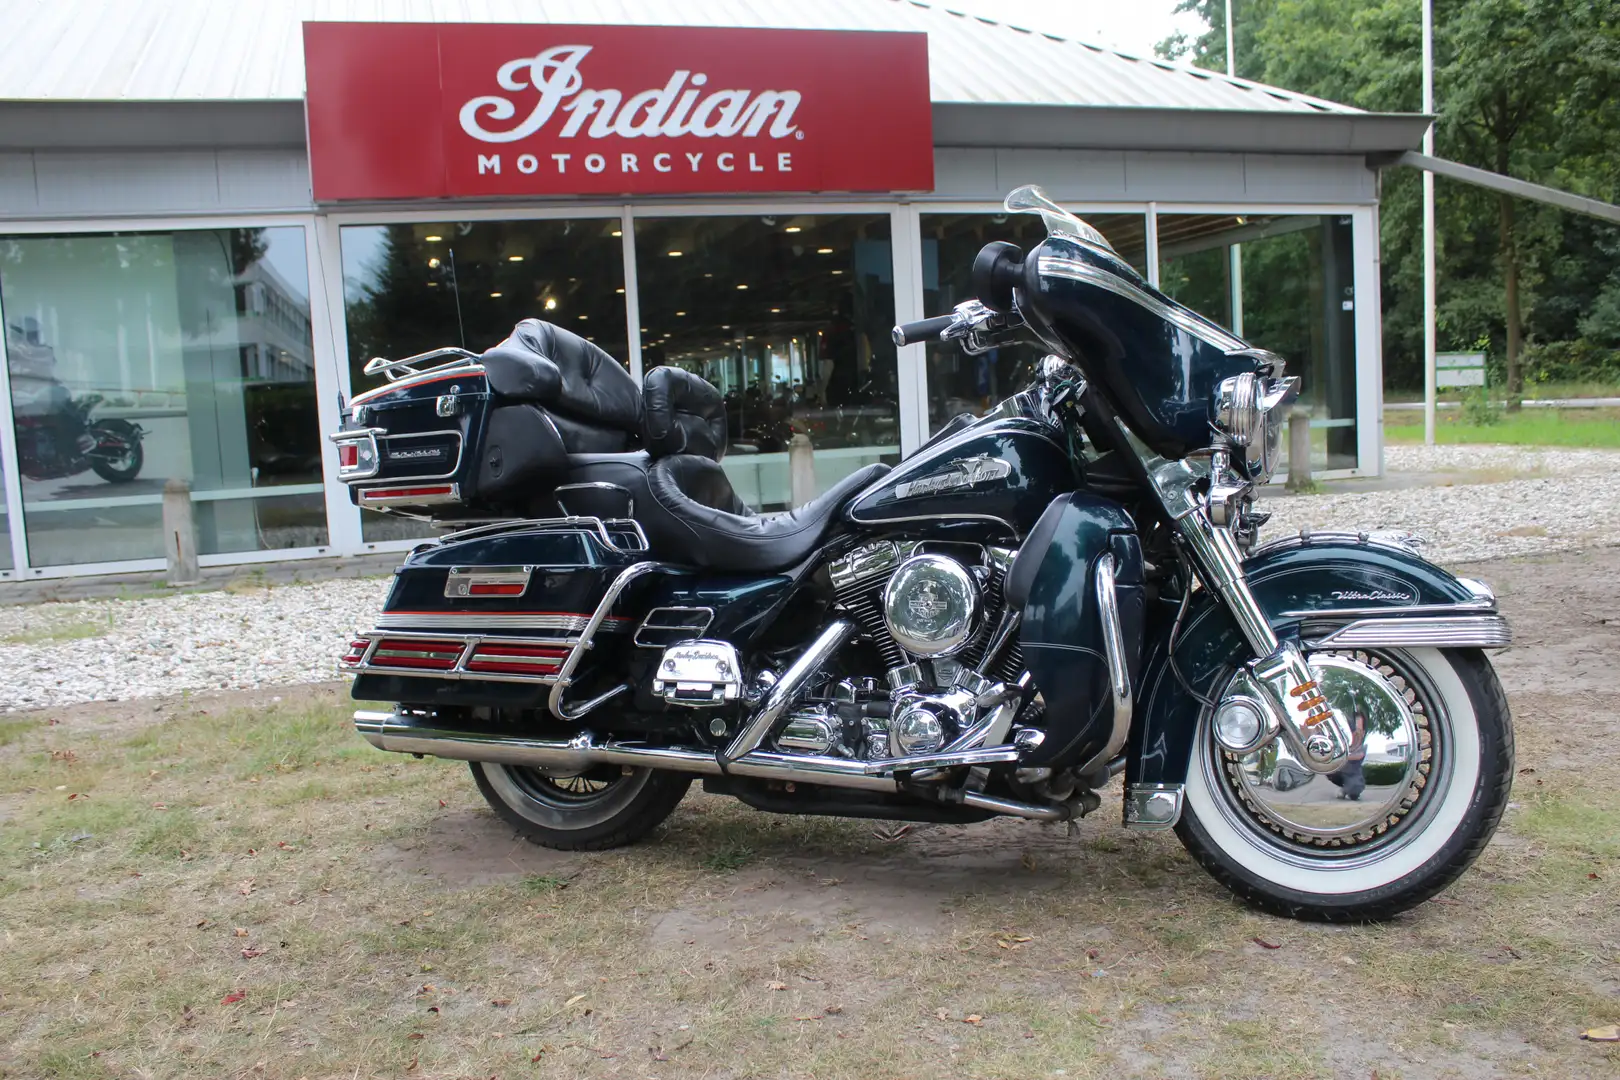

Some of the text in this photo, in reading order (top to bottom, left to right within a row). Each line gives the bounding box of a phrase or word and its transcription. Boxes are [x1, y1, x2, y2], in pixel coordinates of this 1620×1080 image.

[459, 45, 803, 143] Indian
[478, 152, 793, 175] MOTORCYCLE
[1331, 588, 1411, 601] Ultra Classic
